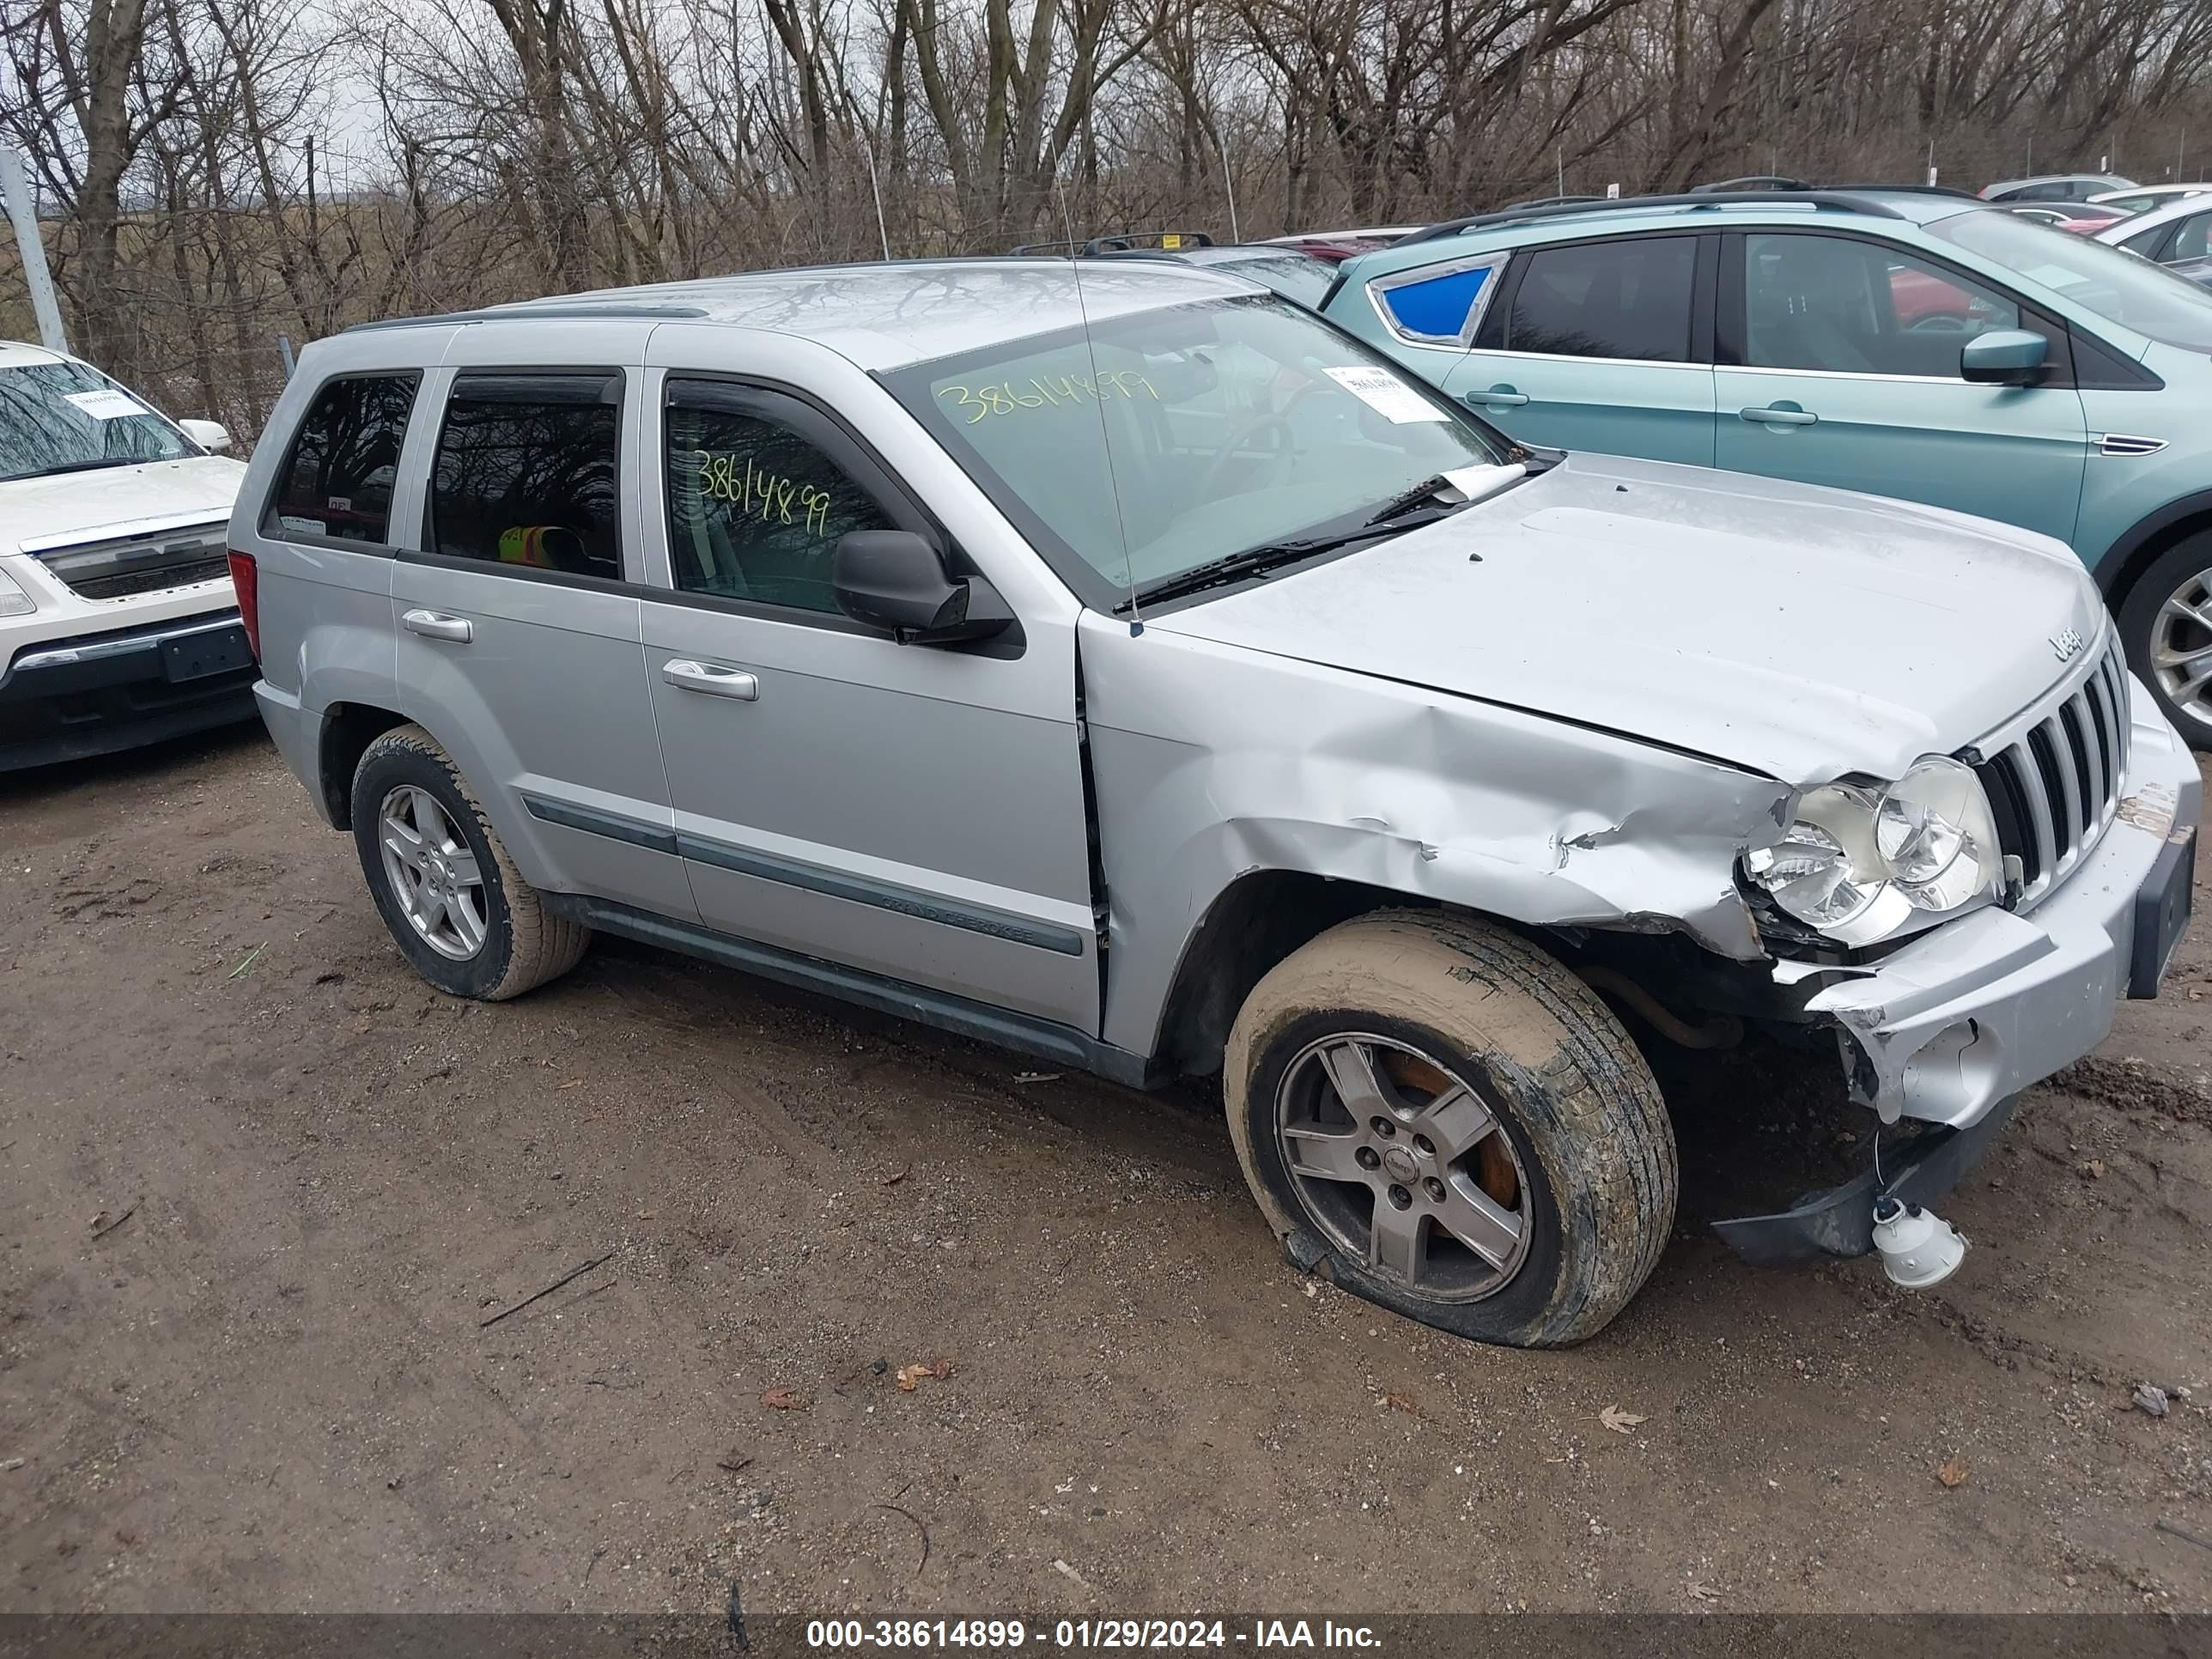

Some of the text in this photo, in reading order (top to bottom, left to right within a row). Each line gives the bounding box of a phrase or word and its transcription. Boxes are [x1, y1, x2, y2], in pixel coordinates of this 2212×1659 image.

[938, 370, 1159, 424] 38614899
[694, 449, 830, 538] 38614899
[2048, 627, 2083, 663] Jeep
[882, 895, 1034, 942] GRAND CHEROKEE
